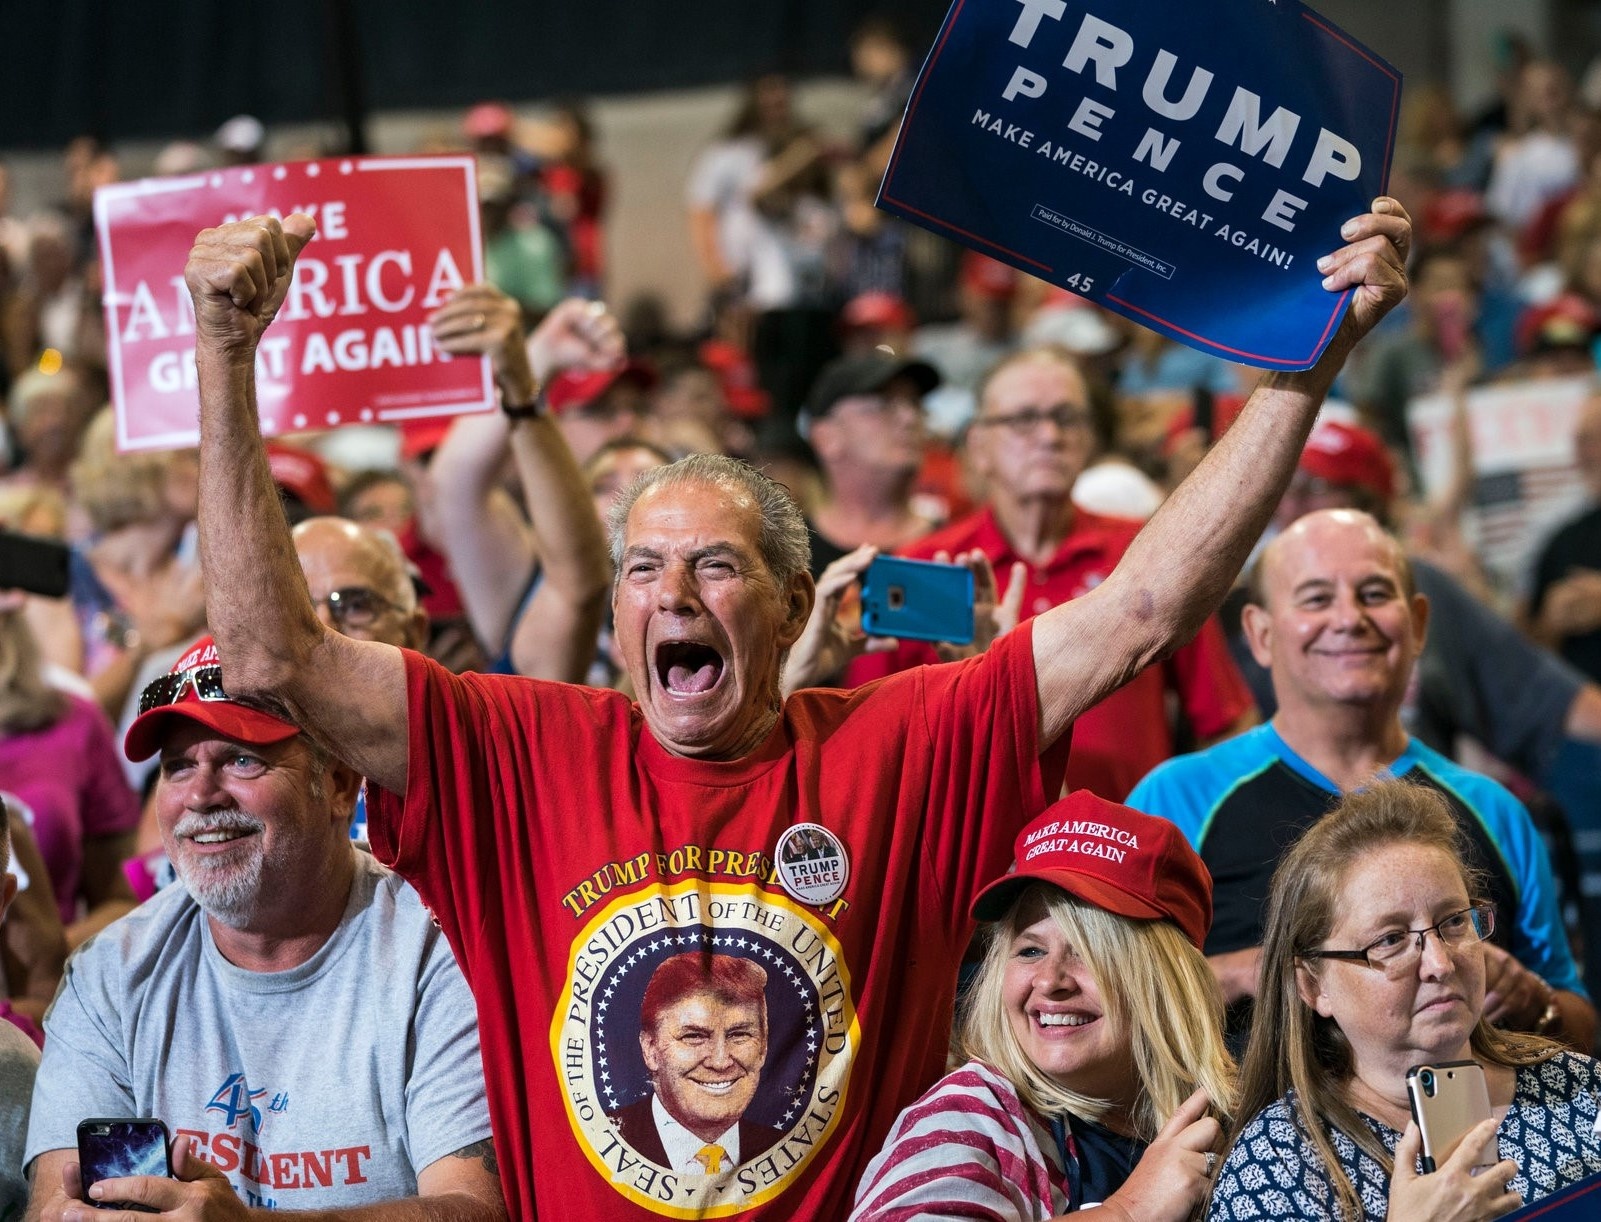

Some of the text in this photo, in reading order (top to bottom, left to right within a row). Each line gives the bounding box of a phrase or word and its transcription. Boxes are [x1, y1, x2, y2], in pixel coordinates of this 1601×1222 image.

[1008, 0, 1362, 188] TRUMP
[1001, 66, 1309, 232] PENCE
[971, 109, 1294, 270] MAKE AMERICA GREAT AGAIN!
[1038, 209, 1052, 220] Paid
[1052, 215, 1062, 225] for
[1062, 219, 1070, 229] by
[1070, 223, 1093, 239] Donald
[1097, 235, 1117, 250] Trump
[1116, 244, 1127, 254] for
[1126, 249, 1155, 269] President,
[1155, 263, 1167, 274] Inc.
[122, 247, 464, 343] ARICA
[1067, 272, 1094, 293] 45
[789, 860, 839, 877] TRUMP
[1024, 820, 1139, 849] MAKE AMERICA
[1026, 839, 1127, 864] GREAT AGAIN
[562, 845, 849, 920] TRUMP FOR PRESIT
[794, 871, 840, 887] PENCE
[565, 893, 848, 1201] SEAL OF THE PRESIDENT OF THE UNITED STATES
